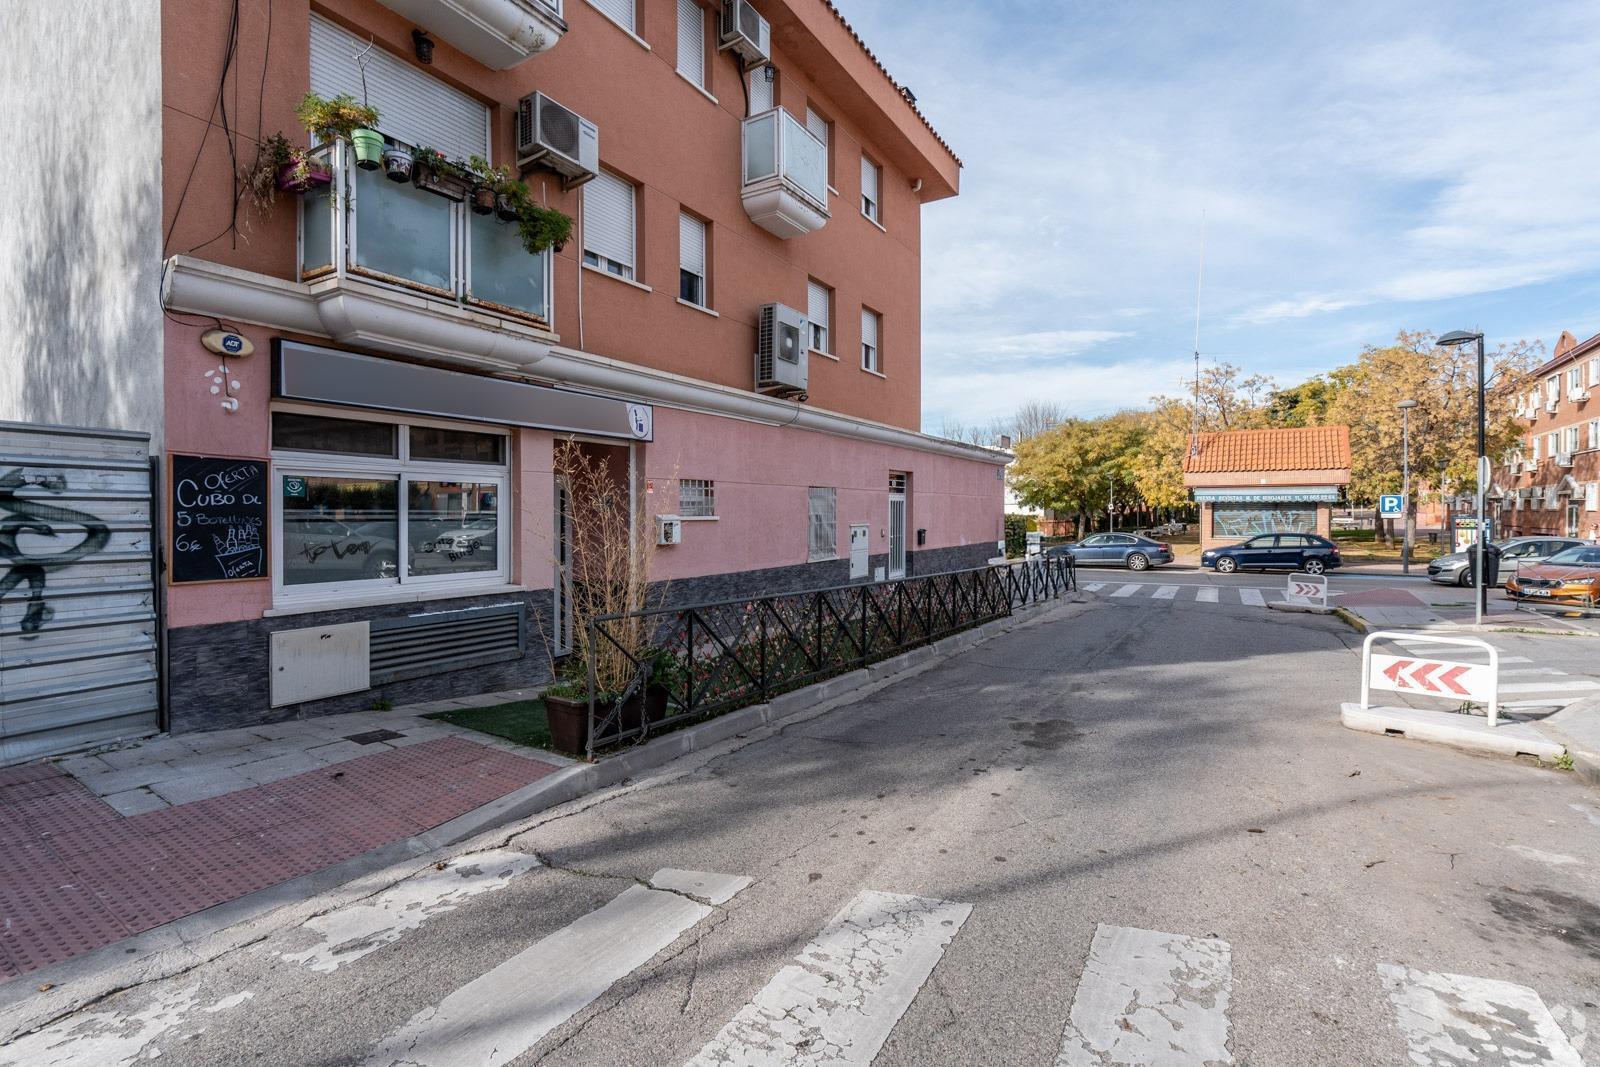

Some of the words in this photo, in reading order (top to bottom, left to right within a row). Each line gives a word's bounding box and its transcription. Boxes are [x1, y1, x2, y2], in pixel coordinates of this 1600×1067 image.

[225, 340, 240, 348] ADT
[177, 479, 235, 508] CUBO
[1385, 498, 1398, 511] P
[176, 511, 192, 527] 5
